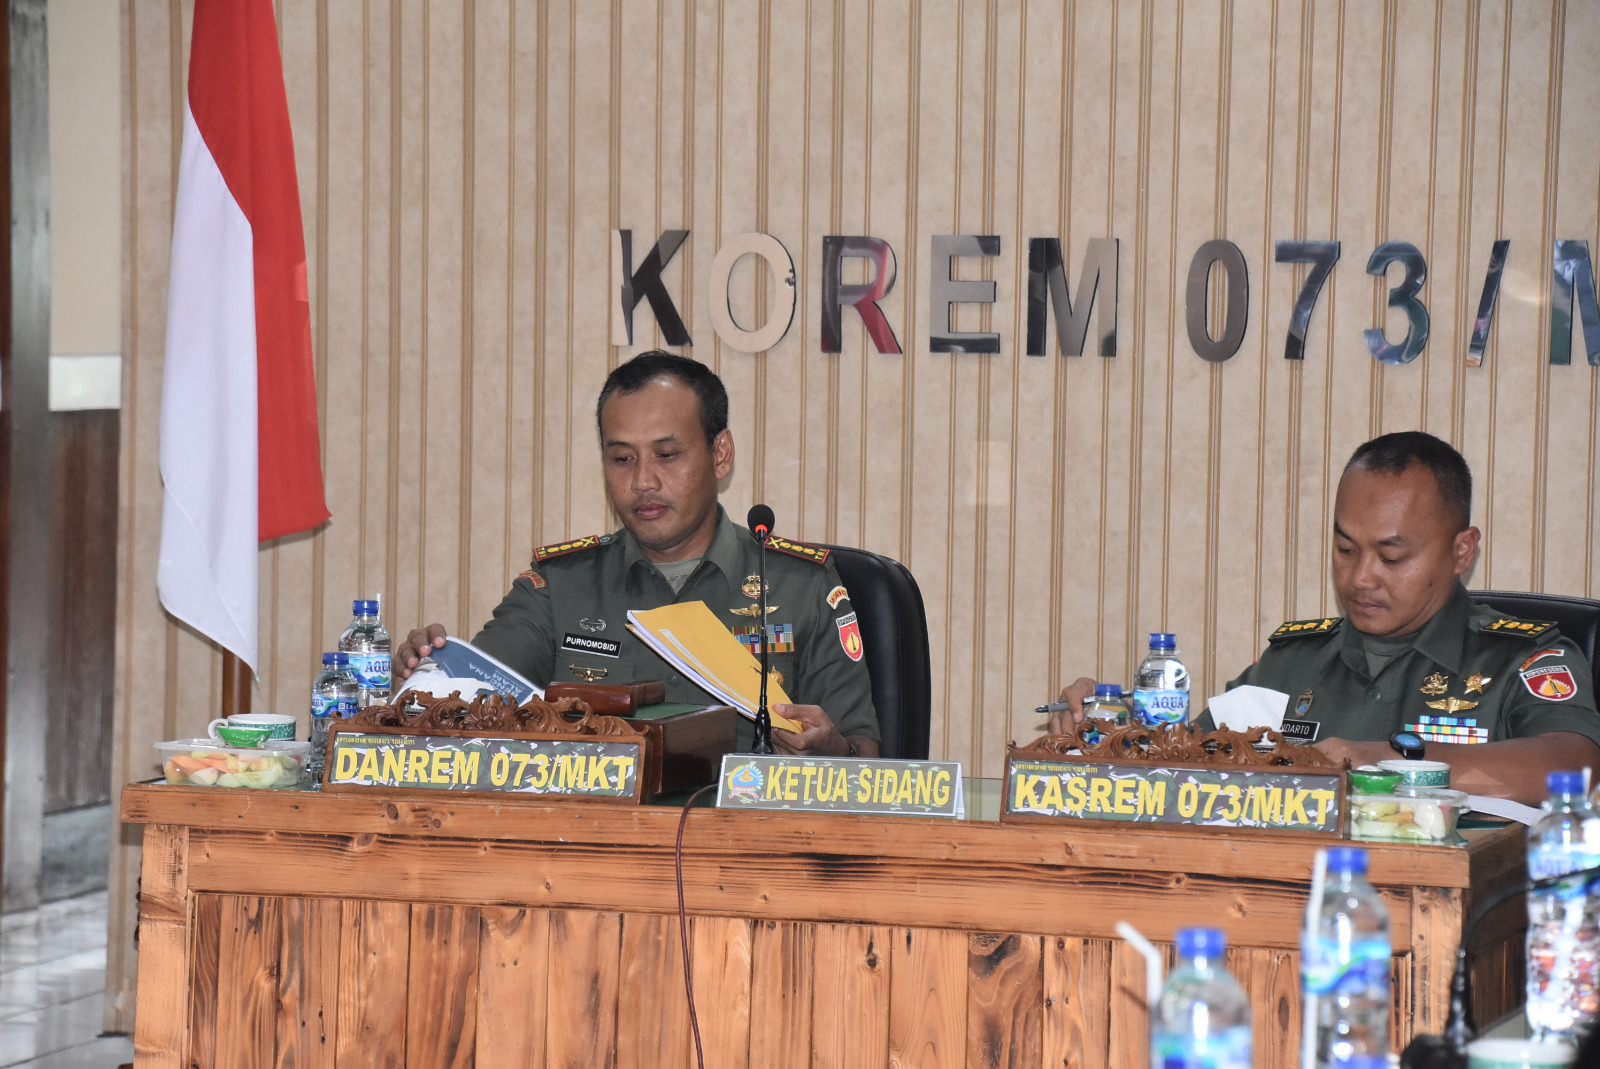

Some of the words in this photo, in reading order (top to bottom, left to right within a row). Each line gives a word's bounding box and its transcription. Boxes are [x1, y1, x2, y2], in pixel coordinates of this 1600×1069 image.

[611, 229, 1119, 357] KOREM
[566, 636, 618, 652] PURNOMOSIDI
[1151, 696, 1184, 711] AQUA
[335, 747, 481, 785] DANREM
[490, 752, 635, 790] 073/MKT
[766, 765, 849, 803] KETUA
[857, 767, 950, 806] SIDANG
[1014, 774, 1167, 817] KASREM
[1177, 782, 1336, 826] 073/MKT
